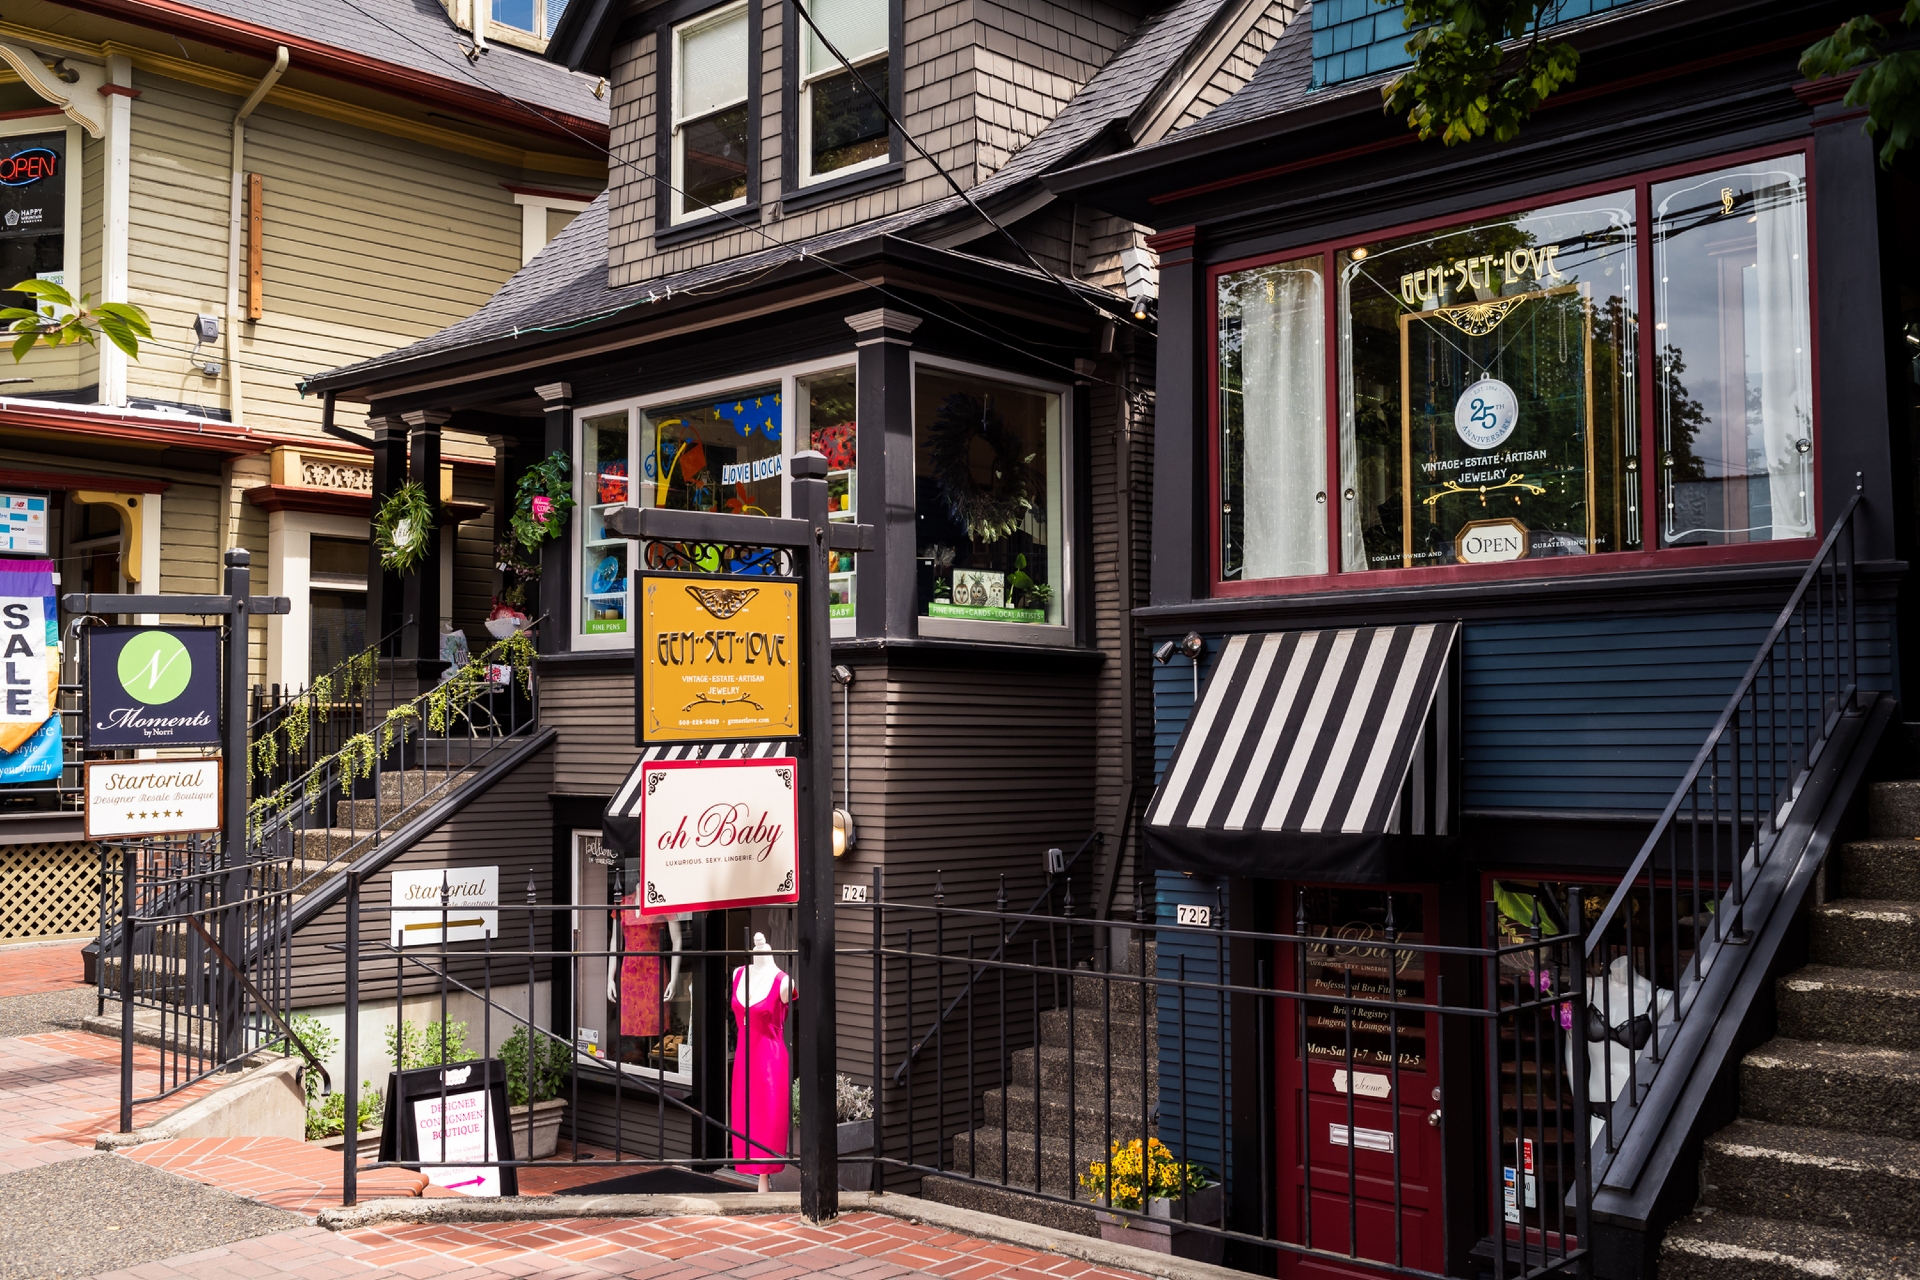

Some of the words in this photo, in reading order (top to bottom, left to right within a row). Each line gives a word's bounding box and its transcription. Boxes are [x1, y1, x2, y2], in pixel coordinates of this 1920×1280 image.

[0, 156, 56, 179] OPEN
[21, 208, 43, 216] HAPPY
[1462, 418, 1511, 443] ANNIVERSARY
[723, 465, 749, 482] LOVE
[1458, 468, 1507, 483] JEWELRY
[1466, 536, 1518, 555] OPEN
[1532, 541, 1565, 549] CURATED
[1372, 554, 1400, 562] LOCALLY
[932, 606, 947, 614] FINE
[949, 607, 964, 615] PENS
[969, 608, 991, 617] CARDS
[995, 610, 1015, 619] LOCAL
[3, 604, 34, 716] SALE
[707, 686, 740, 695] JEWELRY
[96, 706, 212, 730] Moments
[727, 717, 770, 726] gemsetlove.com
[143, 728, 152, 738] by
[152, 727, 174, 736] Norri
[20, 760, 53, 777] family
[105, 769, 204, 792] Startorial
[93, 795, 136, 806] Designer
[138, 792, 171, 803] Resale
[173, 791, 215, 801] Boutique
[657, 815, 691, 851] oh
[695, 802, 784, 863] Baby
[665, 858, 703, 867] LUXURIOUS.
[724, 854, 754, 863] LINGERIE.
[404, 879, 487, 900] Starorial
[844, 887, 865, 900] 724
[1179, 907, 1208, 924] 722
[1315, 979, 1360, 991] Professioal
[1361, 982, 1376, 993] Bra
[1358, 1008, 1389, 1021] Registry
[1359, 1020, 1406, 1034] Loungewar
[1353, 1047, 1368, 1059] 1-7
[1398, 1053, 1420, 1066] 12-5
